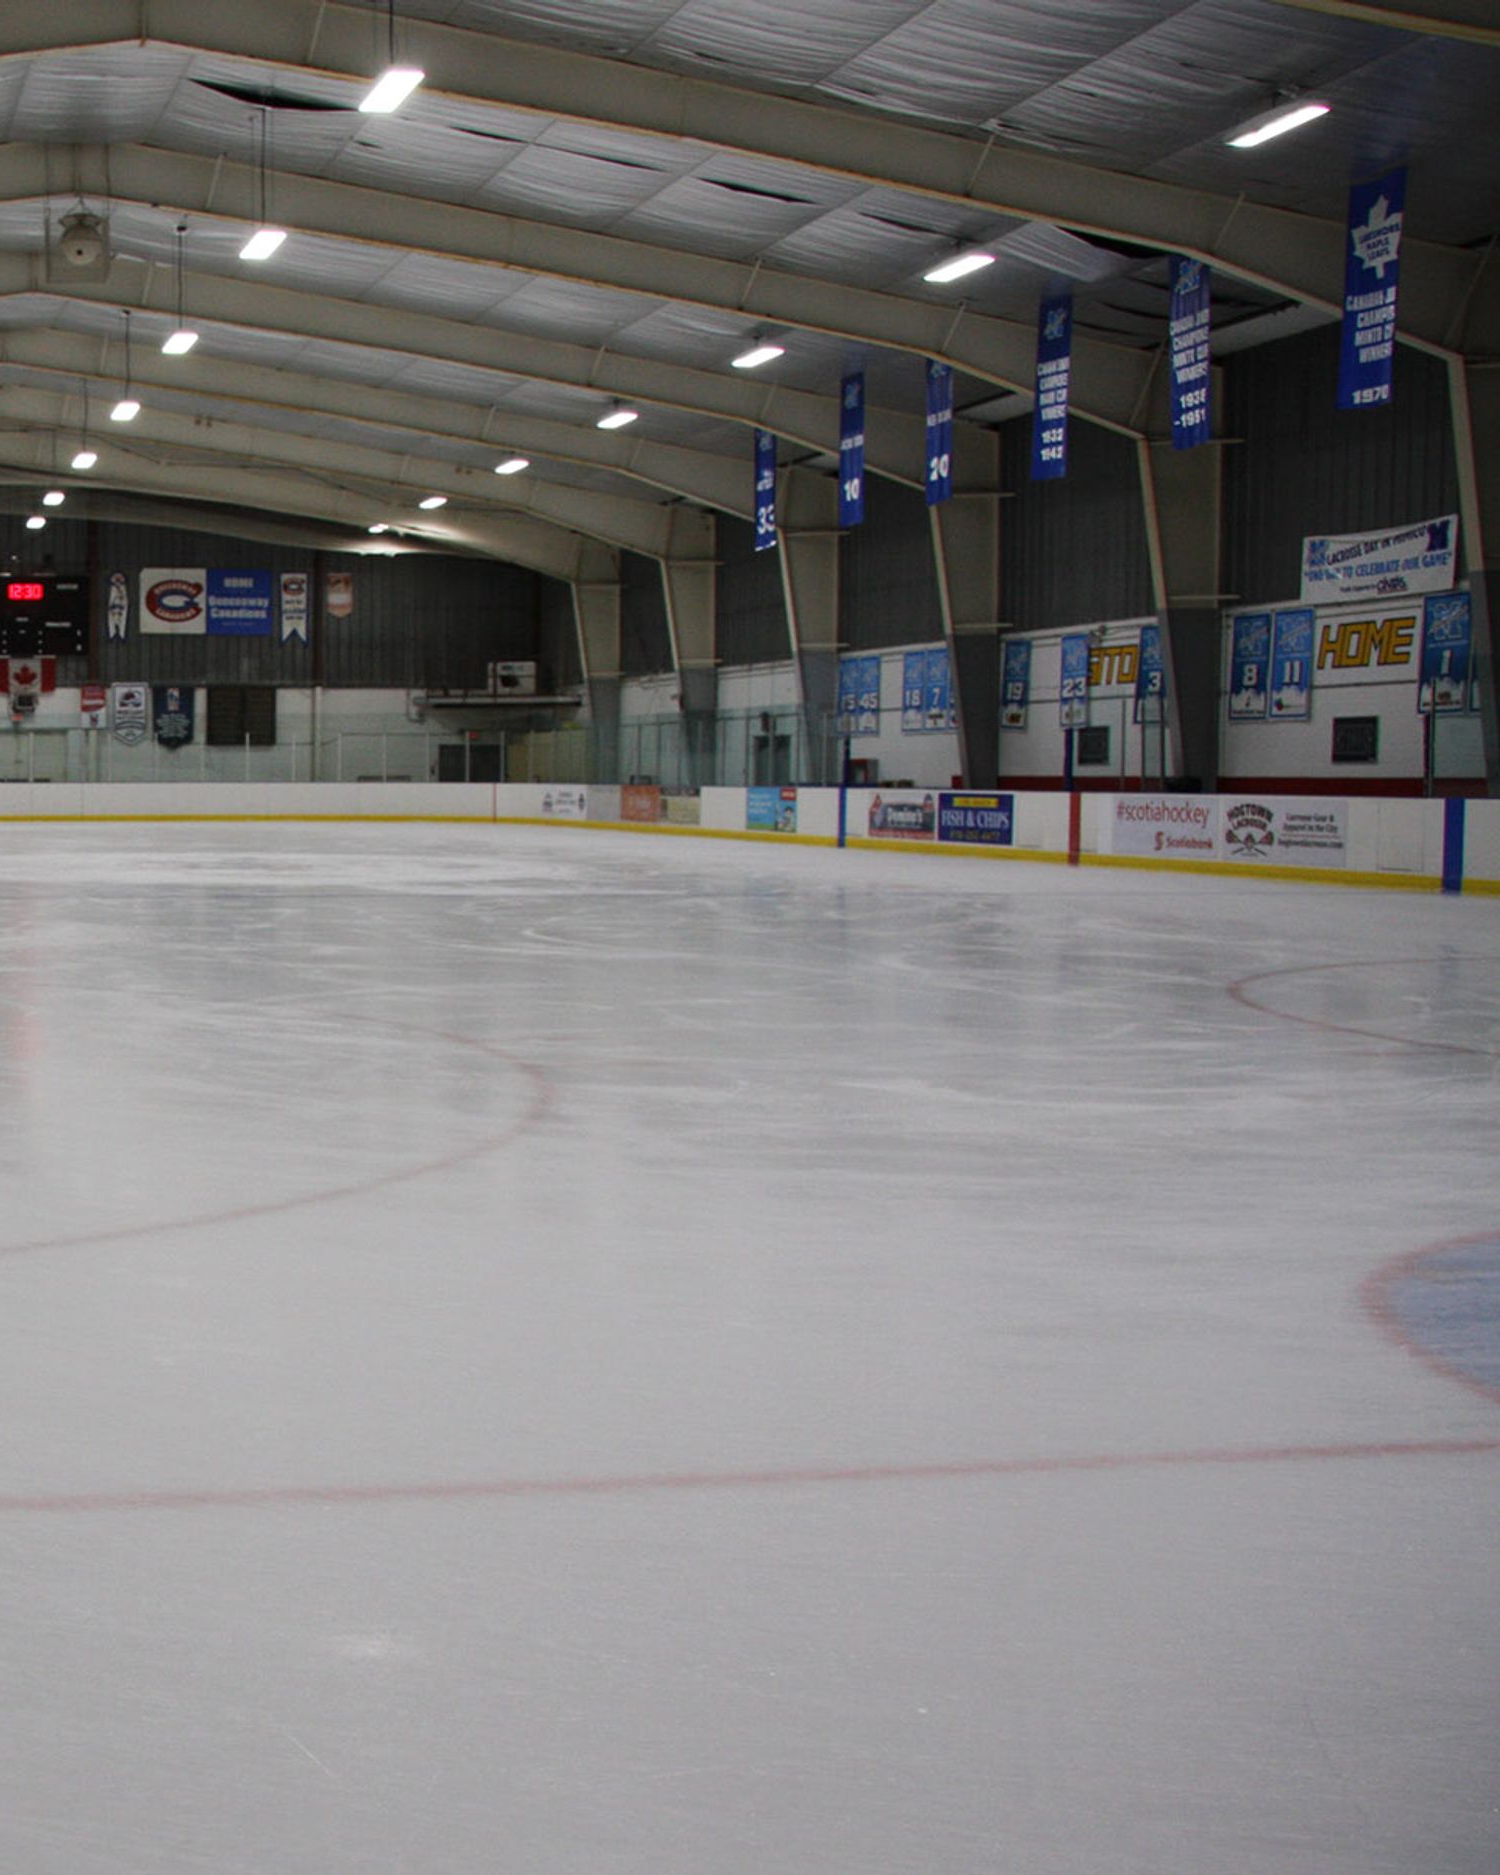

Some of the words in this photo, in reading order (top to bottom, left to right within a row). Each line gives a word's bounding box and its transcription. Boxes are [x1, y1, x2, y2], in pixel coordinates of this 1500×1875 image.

[929, 453, 950, 481] 20
[844, 478, 860, 501] 10
[1355, 559, 1401, 577] CELEBRATE
[1317, 615, 1417, 669] HOME
[1088, 645, 1139, 686] SITO
[1243, 664, 1257, 686] 8
[1283, 660, 1302, 683] 11
[1007, 682, 1023, 700] 19
[1062, 676, 1086, 698] 23
[1147, 671, 1161, 692] 3
[859, 692, 878, 709] 45
[932, 687, 941, 706] 7
[941, 810, 964, 827] FISH
[966, 810, 975, 827] &
[976, 811, 1009, 828] CHIPS
[1116, 800, 1210, 829] #scotiahockey
